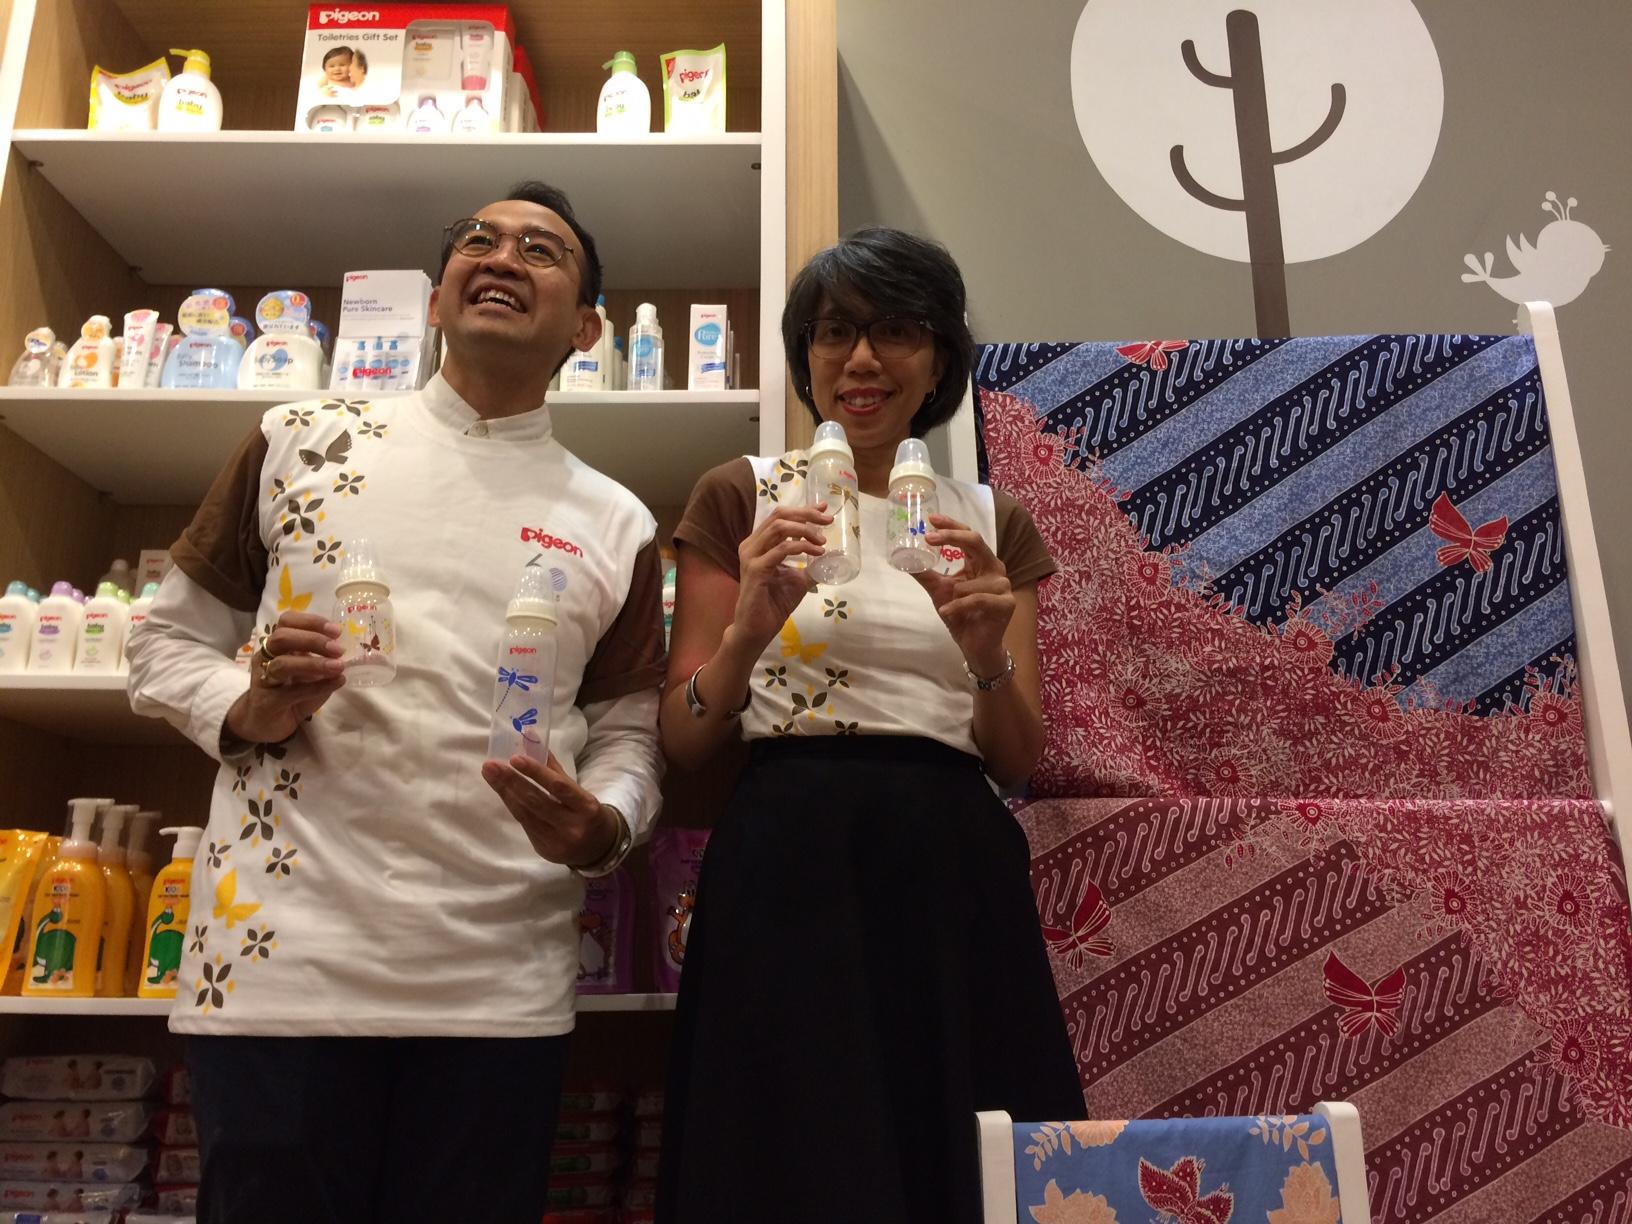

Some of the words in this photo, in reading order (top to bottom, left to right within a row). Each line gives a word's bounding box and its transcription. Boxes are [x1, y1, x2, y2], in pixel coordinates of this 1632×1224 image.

[319, 8, 380, 24] pigeon
[317, 33, 360, 42] Toiletries
[362, 33, 380, 42] Gift
[382, 33, 399, 42] Set
[352, 367, 392, 379] pigeon
[521, 527, 584, 558] pigeon
[940, 545, 967, 562] igeo
[509, 645, 537, 655] pigeon
